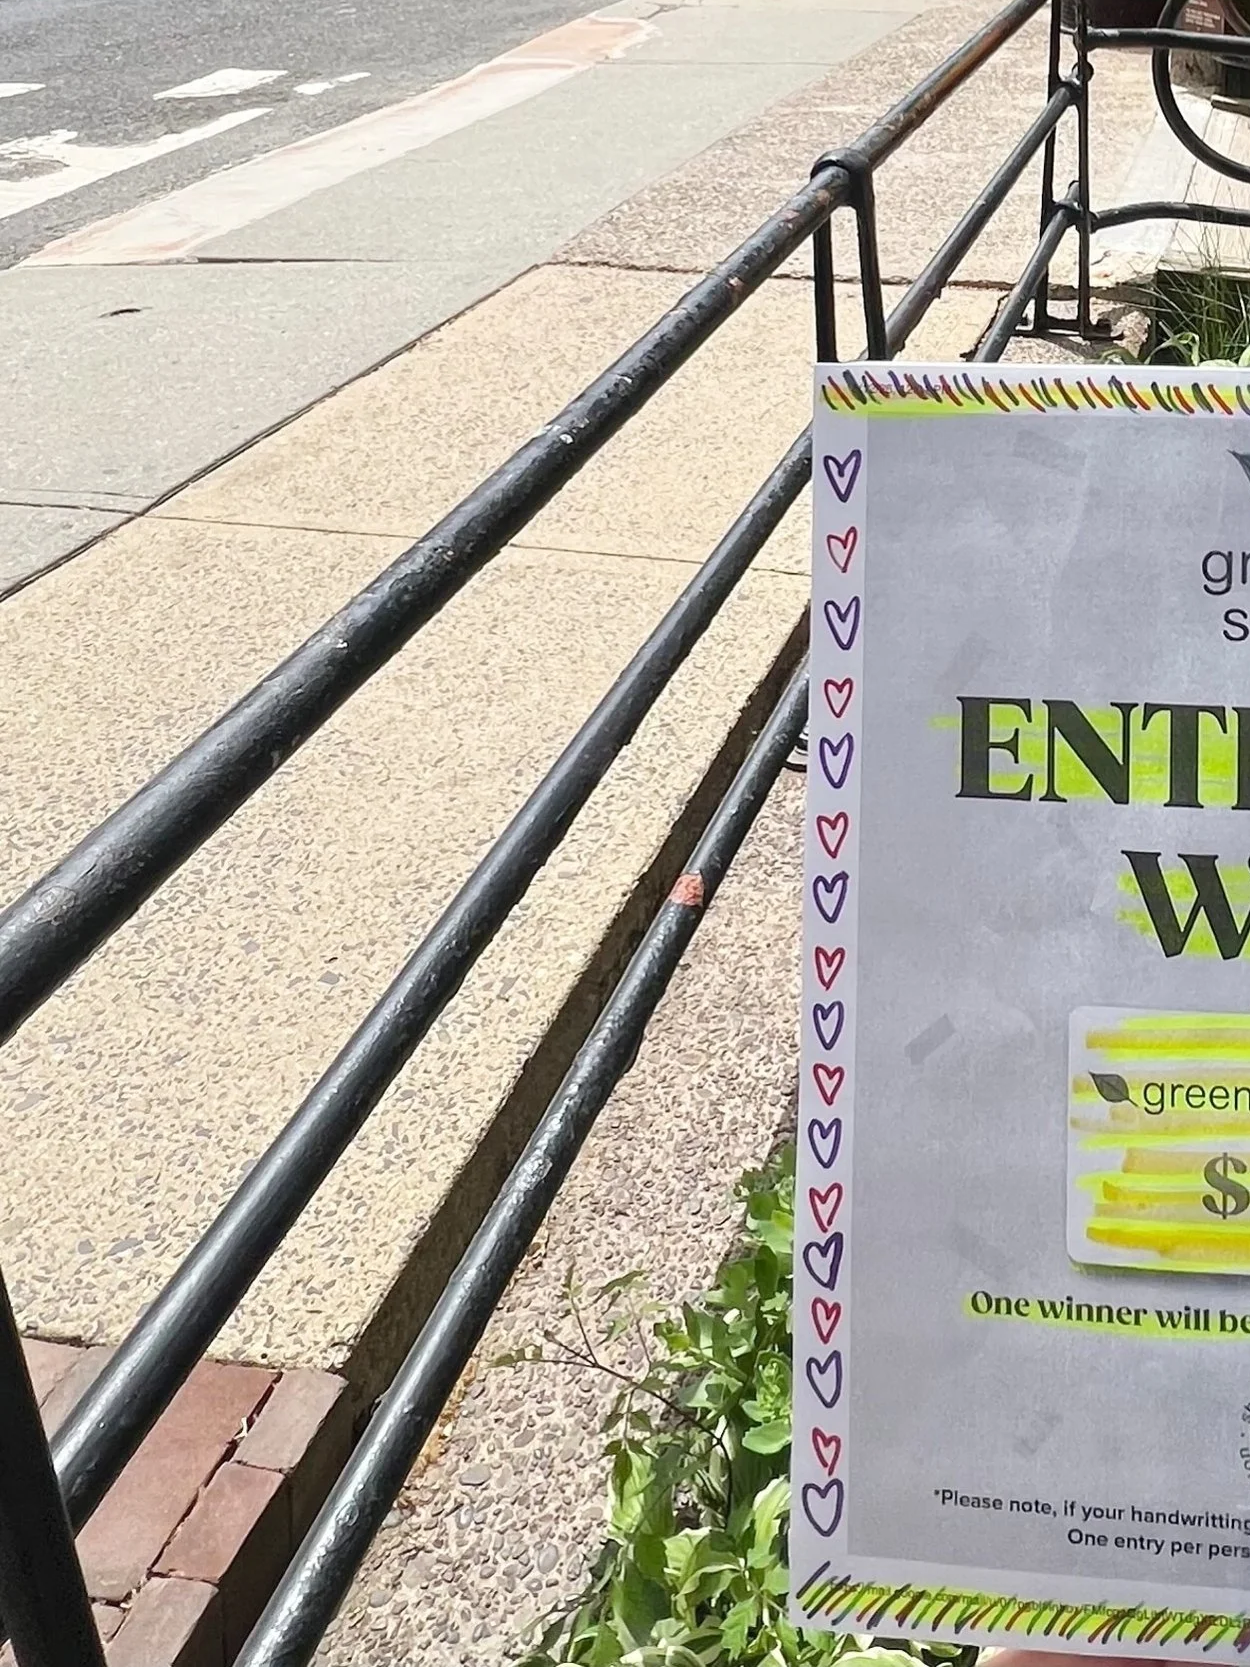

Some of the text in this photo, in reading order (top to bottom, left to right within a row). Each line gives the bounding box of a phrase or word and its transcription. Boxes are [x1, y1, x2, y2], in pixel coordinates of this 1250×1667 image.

[970, 1290, 1031, 1318] One
[1037, 1295, 1148, 1327] winner
[1155, 1305, 1211, 1332] will
[1009, 1497, 1058, 1518] note,
[1063, 1499, 1076, 1517] if
[1081, 1505, 1126, 1522] your
[1067, 1528, 1109, 1547] One
[1114, 1534, 1166, 1556] entry
[1170, 1539, 1202, 1557] per
